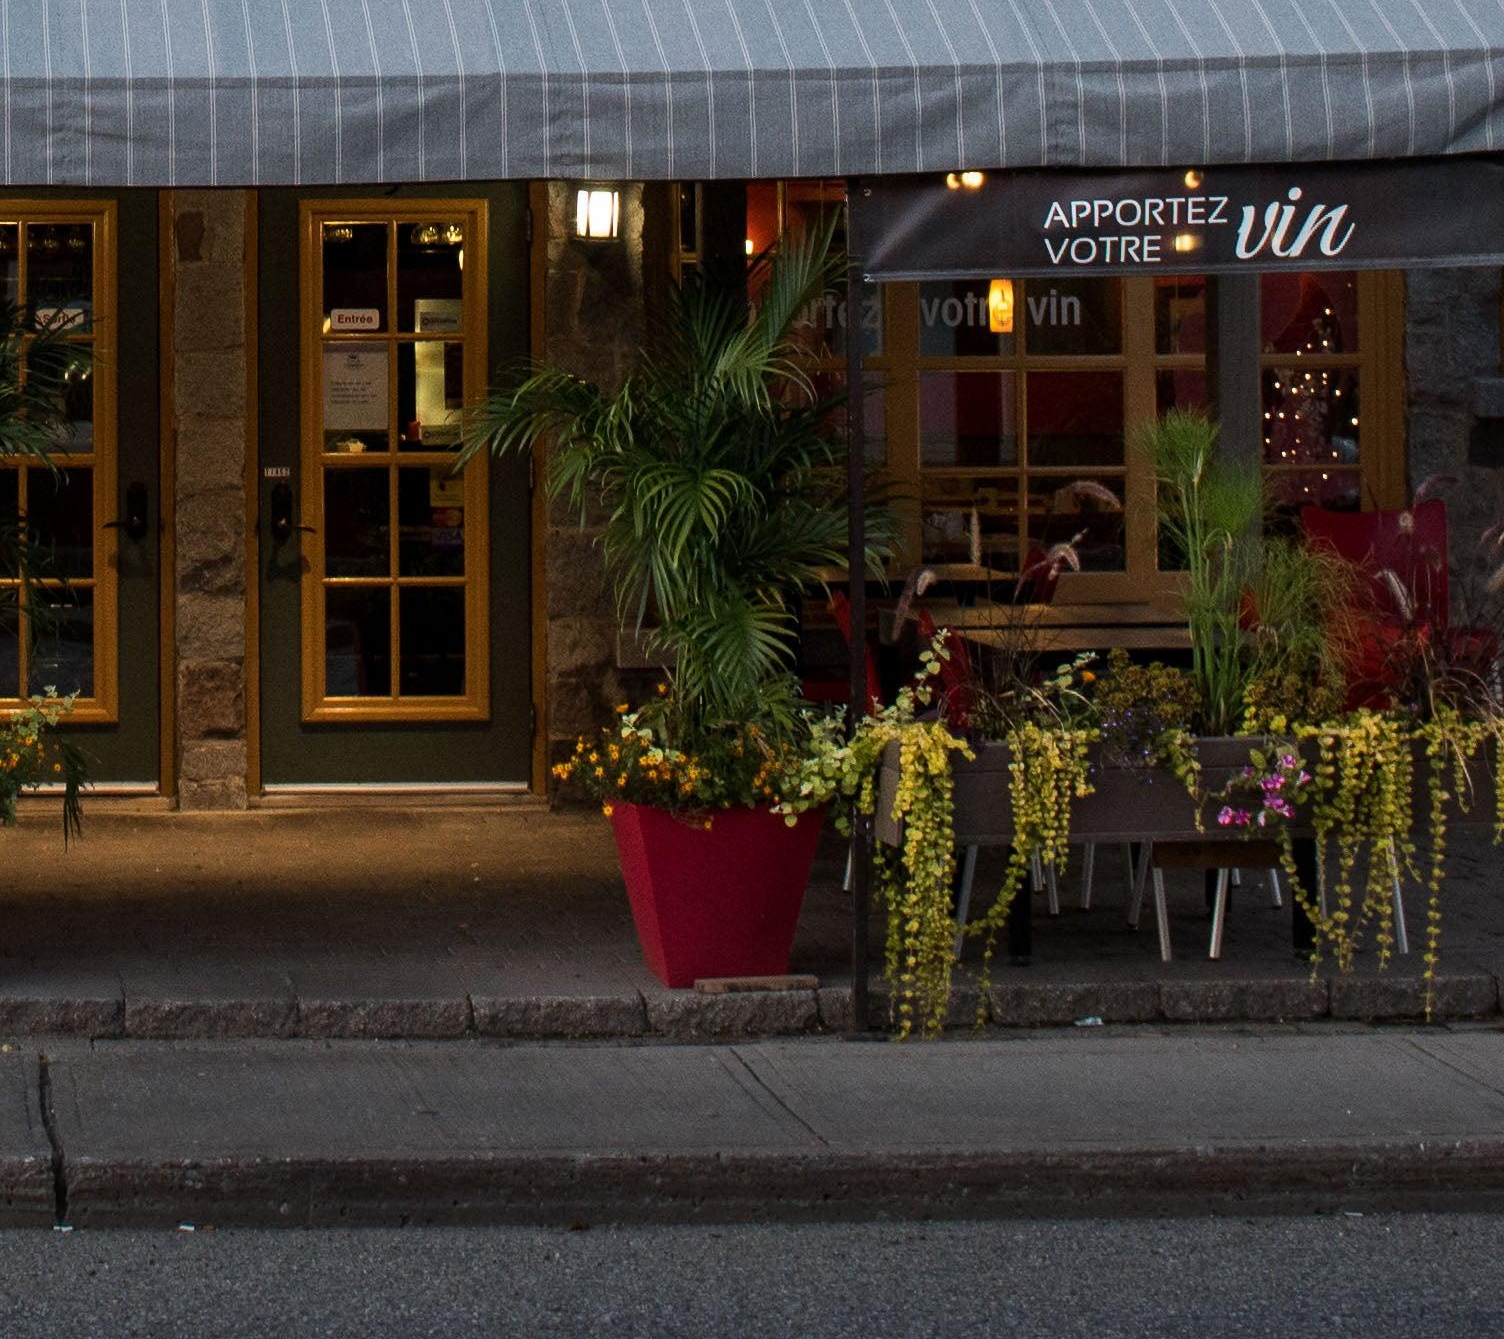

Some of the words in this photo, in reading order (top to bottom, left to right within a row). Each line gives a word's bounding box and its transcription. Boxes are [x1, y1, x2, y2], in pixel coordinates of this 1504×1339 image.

[1043, 196, 1229, 230] APPORTEZ
[1234, 186, 1356, 260] vin
[1043, 234, 1162, 265] VOTRE
[337, 313, 373, 324] Entrée
[1026, 288, 1081, 325] vin
